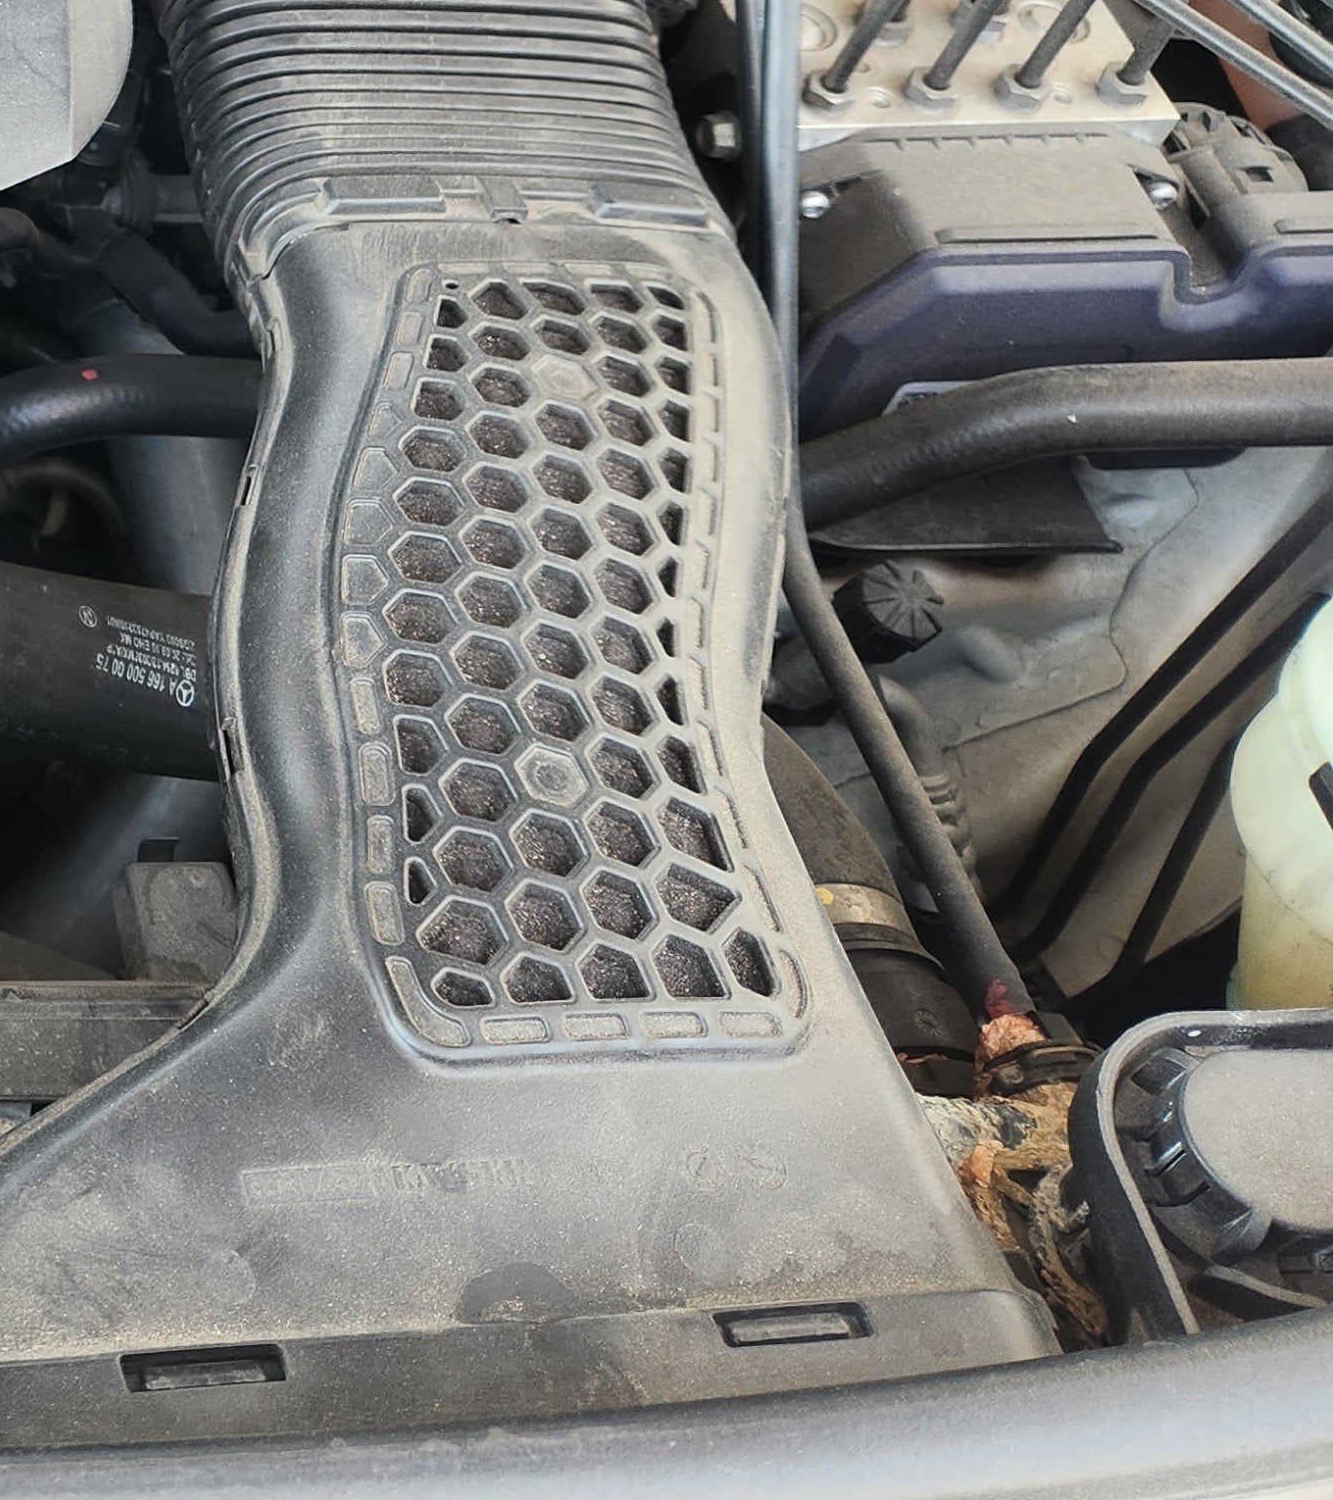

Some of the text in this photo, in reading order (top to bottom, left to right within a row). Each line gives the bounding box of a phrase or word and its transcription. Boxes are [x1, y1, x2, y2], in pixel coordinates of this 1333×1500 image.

[94, 652, 110, 672] 75
[109, 657, 125, 678] 00
[124, 661, 146, 685] 500
[146, 668, 166, 693] 166
[168, 676, 179, 696] A
